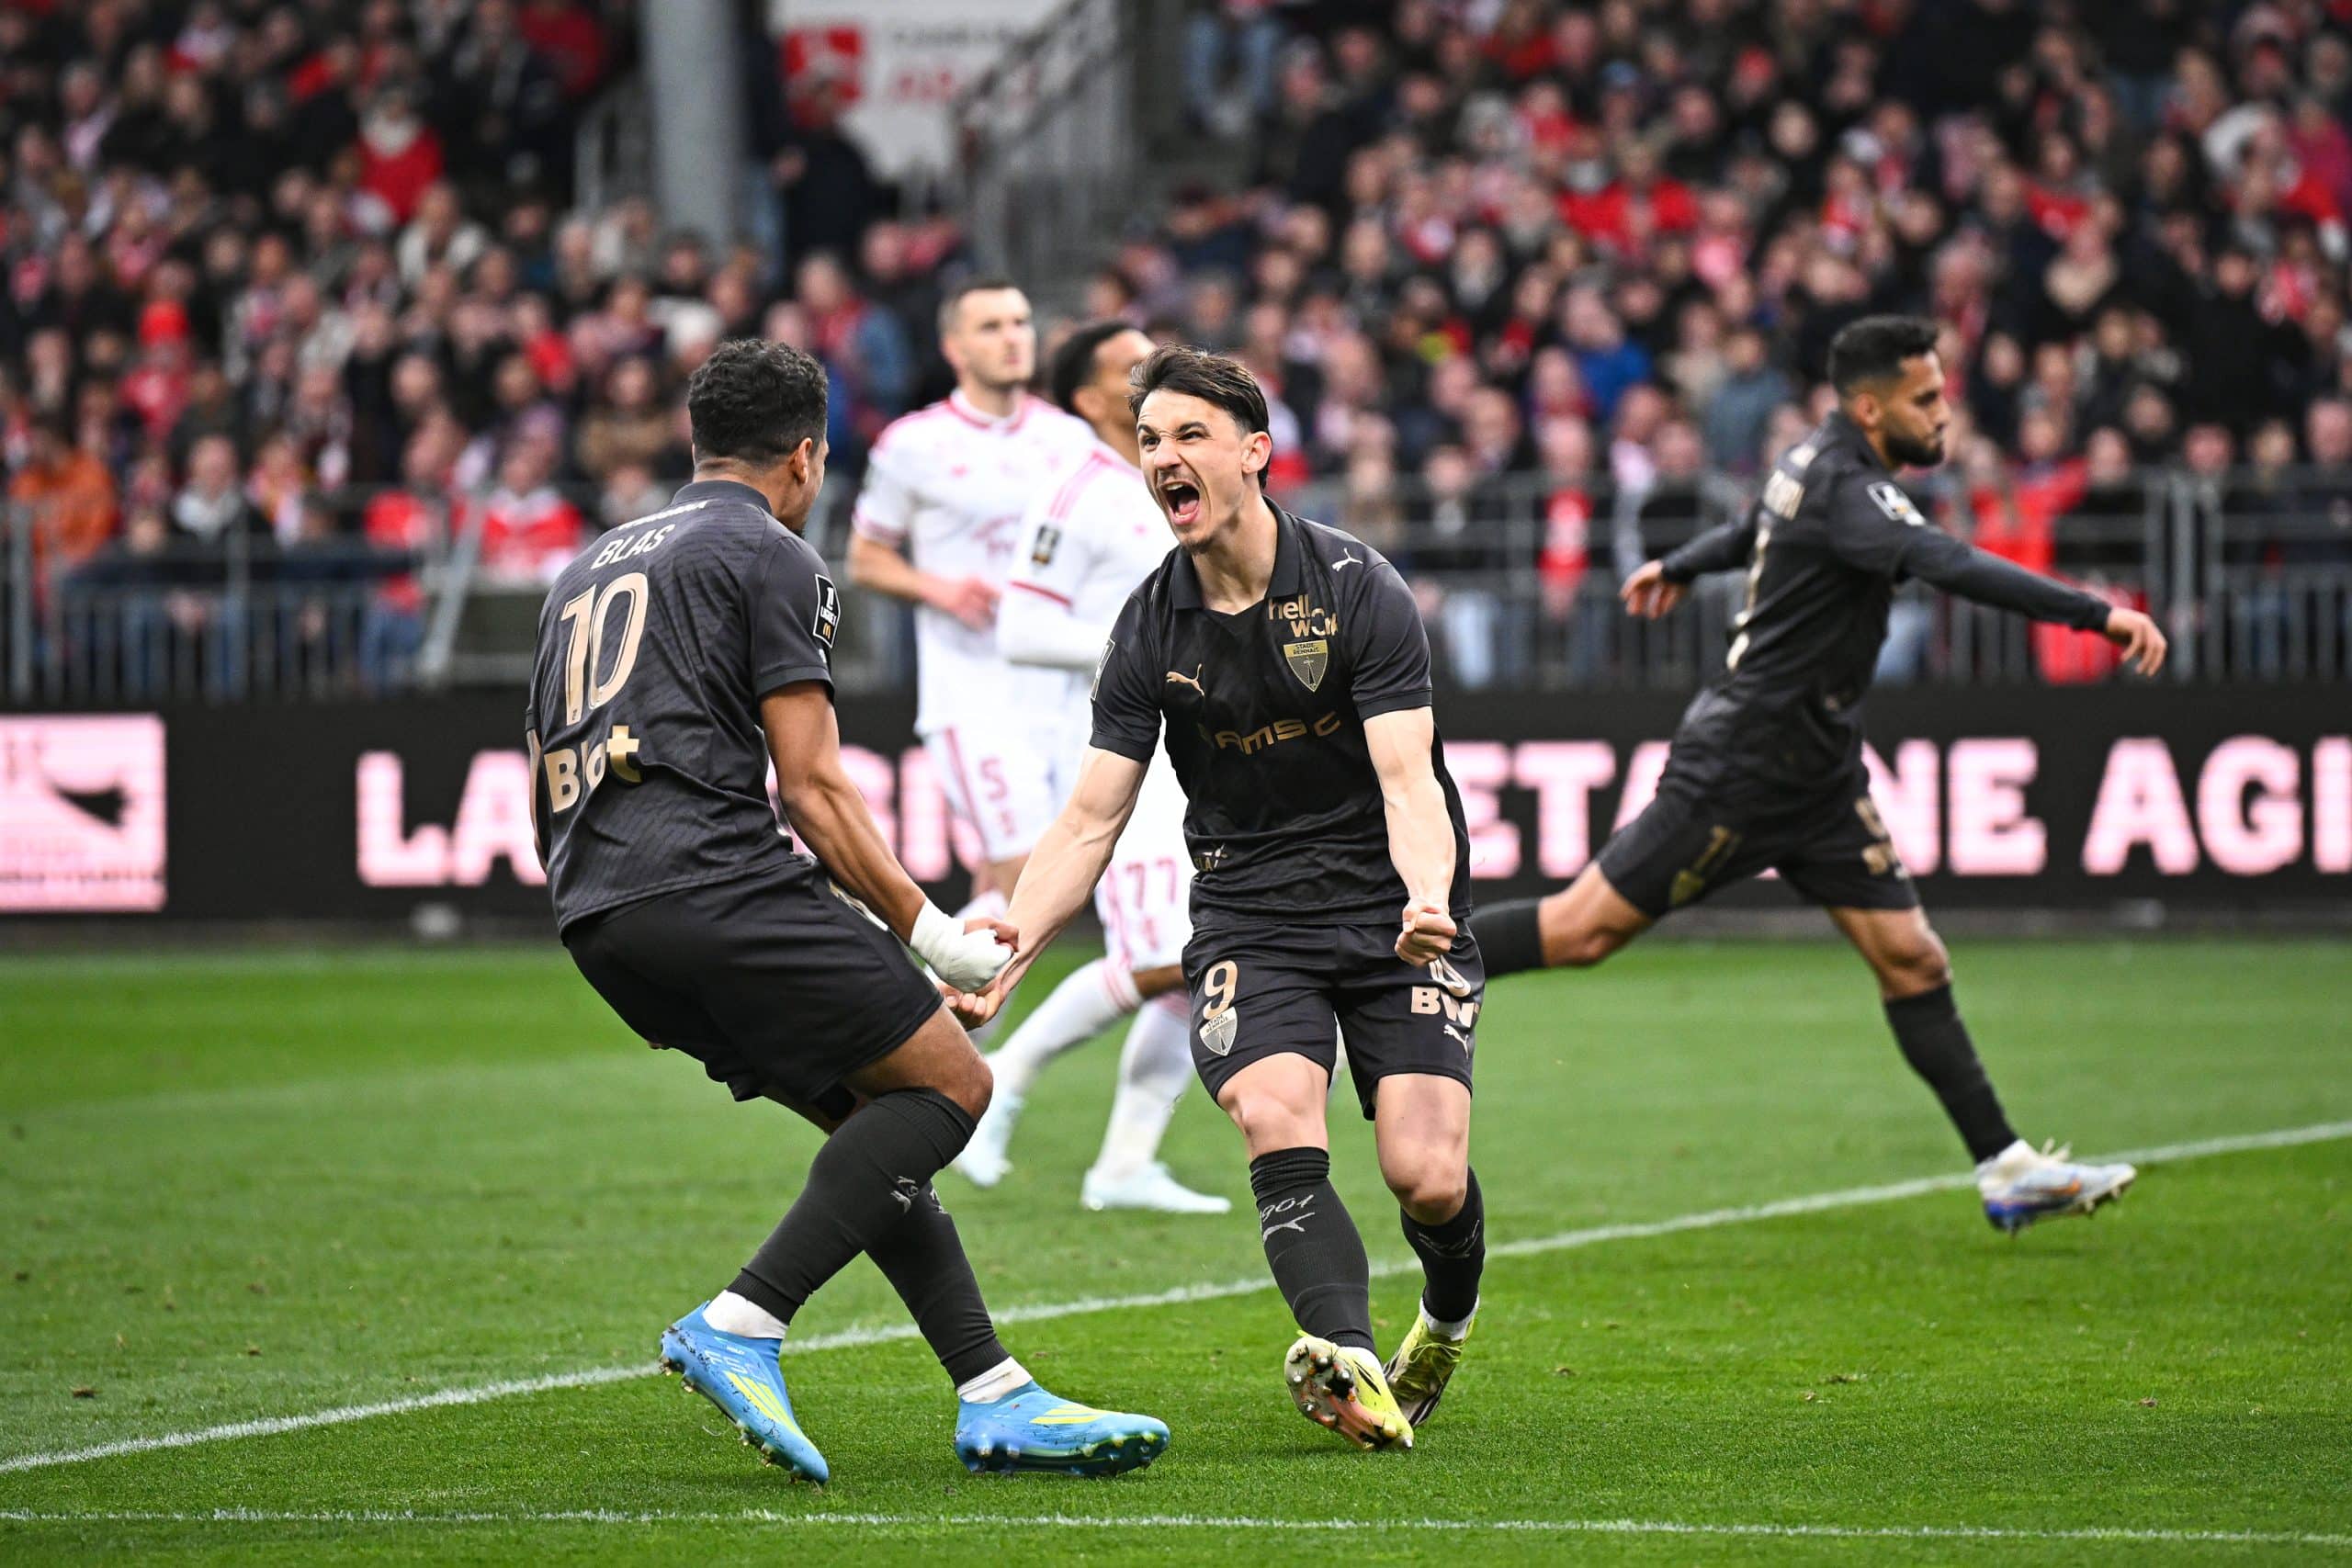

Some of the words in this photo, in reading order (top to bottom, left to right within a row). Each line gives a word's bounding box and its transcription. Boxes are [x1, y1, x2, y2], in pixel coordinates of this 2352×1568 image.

[590, 524, 676, 570] BLAS
[561, 572, 649, 727] 10
[1198, 711, 1341, 755] AMSC
[979, 758, 1008, 801] 5
[356, 749, 548, 886] LA
[1203, 960, 1238, 1020] 9
[1261, 1194, 1314, 1223] 901
